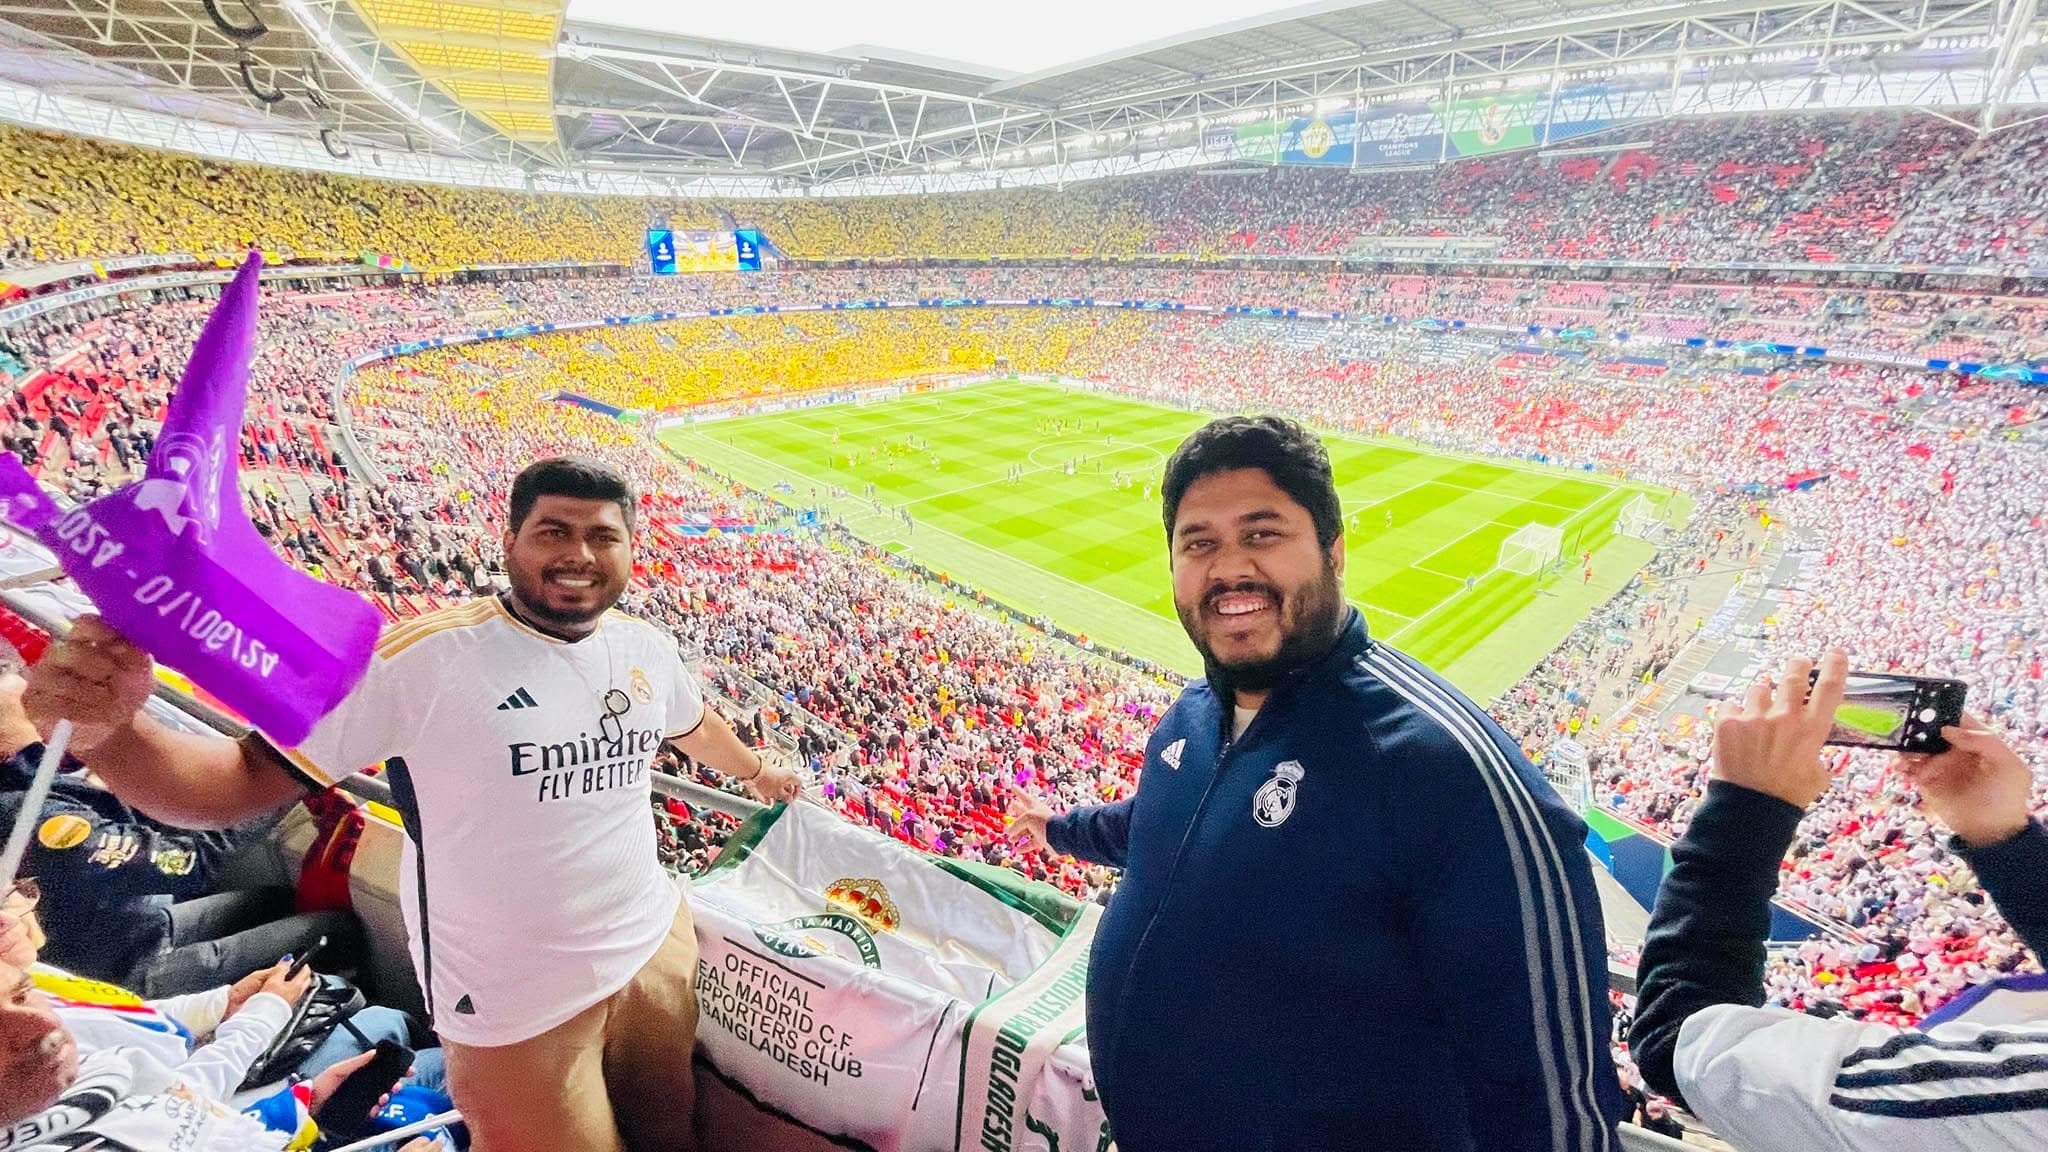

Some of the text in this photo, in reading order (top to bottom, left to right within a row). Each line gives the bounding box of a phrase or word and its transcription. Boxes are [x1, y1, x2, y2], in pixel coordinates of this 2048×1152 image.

[507, 728, 663, 777] Emirates
[538, 759, 644, 802] FLY BETTER
[698, 959, 853, 1057] EAL MADRID C.F.
[725, 953, 814, 1013] OFFICIAL
[701, 997, 829, 1087] BANGLADESH
[804, 1040, 864, 1079] CLUB
